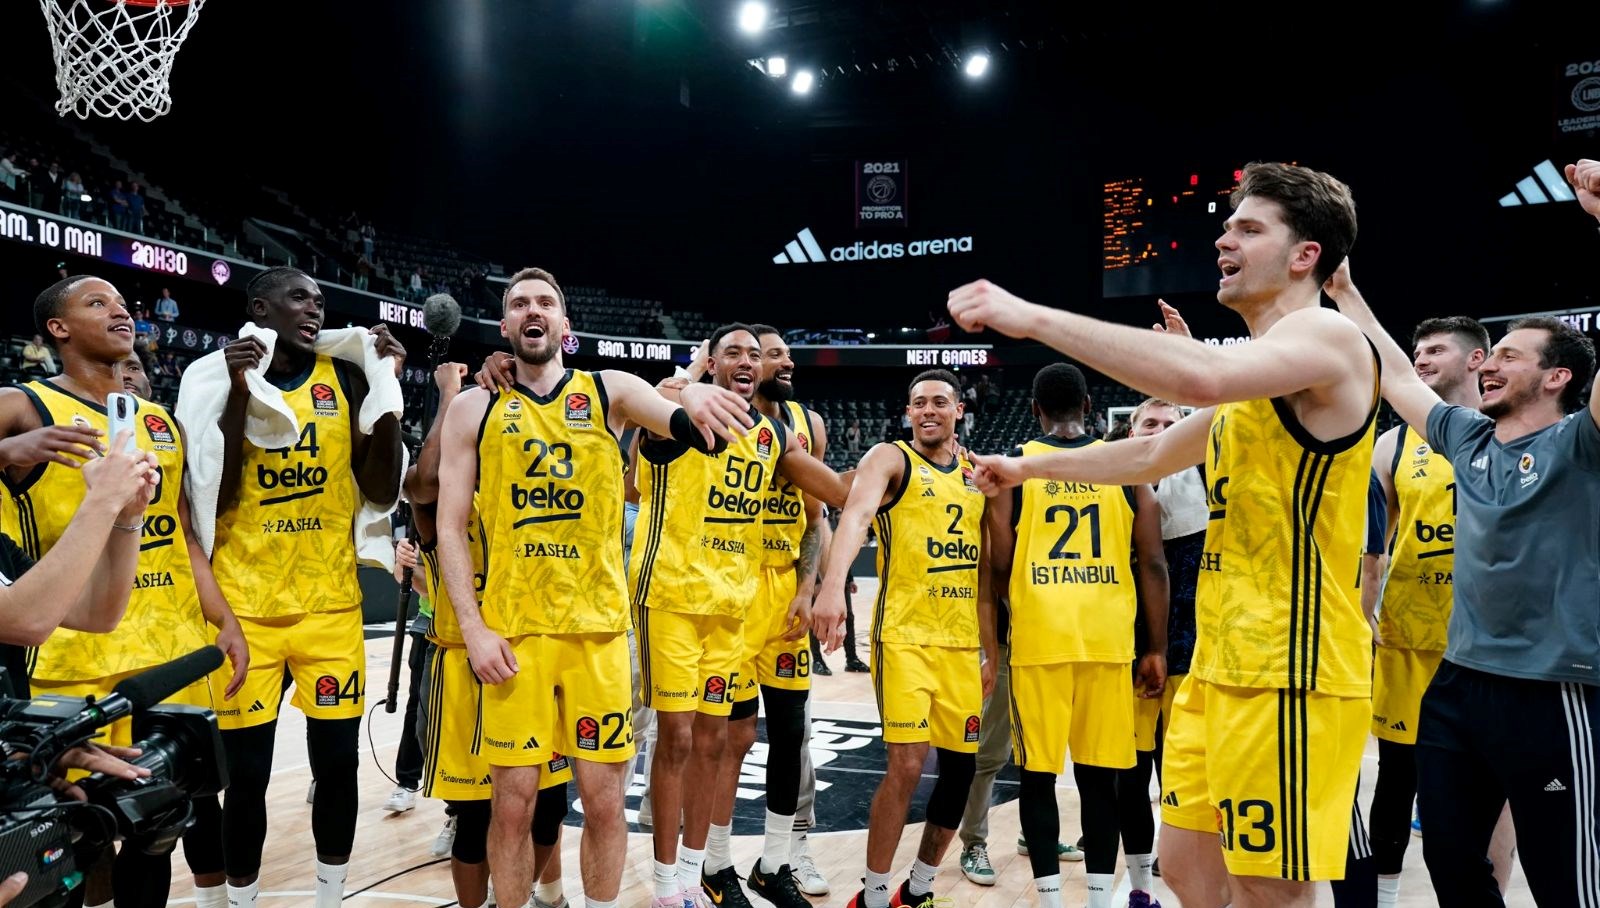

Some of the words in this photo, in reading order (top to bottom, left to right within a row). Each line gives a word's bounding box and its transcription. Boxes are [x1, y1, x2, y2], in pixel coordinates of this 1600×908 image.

[863, 162, 900, 174] 2021
[859, 211, 873, 220] TO
[874, 211, 895, 220] PRO
[895, 211, 904, 220] A
[37, 218, 60, 248] 10
[64, 226, 103, 258] MAI
[829, 241, 905, 262] adidas
[908, 236, 973, 257] arena
[131, 240, 188, 277] 20H30
[379, 300, 408, 325] NEXT
[597, 339, 628, 358] SAM.
[630, 342, 644, 358] 10
[646, 344, 671, 360] MAI
[906, 349, 940, 365] NEXT
[941, 349, 988, 365] GAMES
[523, 438, 575, 479] 23
[257, 461, 328, 490] beko
[724, 455, 764, 493] 50
[511, 482, 584, 511] beko
[1063, 481, 1101, 494] MSC
[708, 485, 761, 517] beko
[275, 517, 323, 533] PASHA
[945, 503, 964, 535] 2
[1045, 503, 1102, 560] 21
[524, 543, 581, 559] PASHA
[711, 537, 745, 554] PASHA
[926, 536, 979, 562] beko
[132, 571, 175, 589] ASHA
[940, 586, 974, 599] PASH
[1218, 798, 1277, 853] 13
